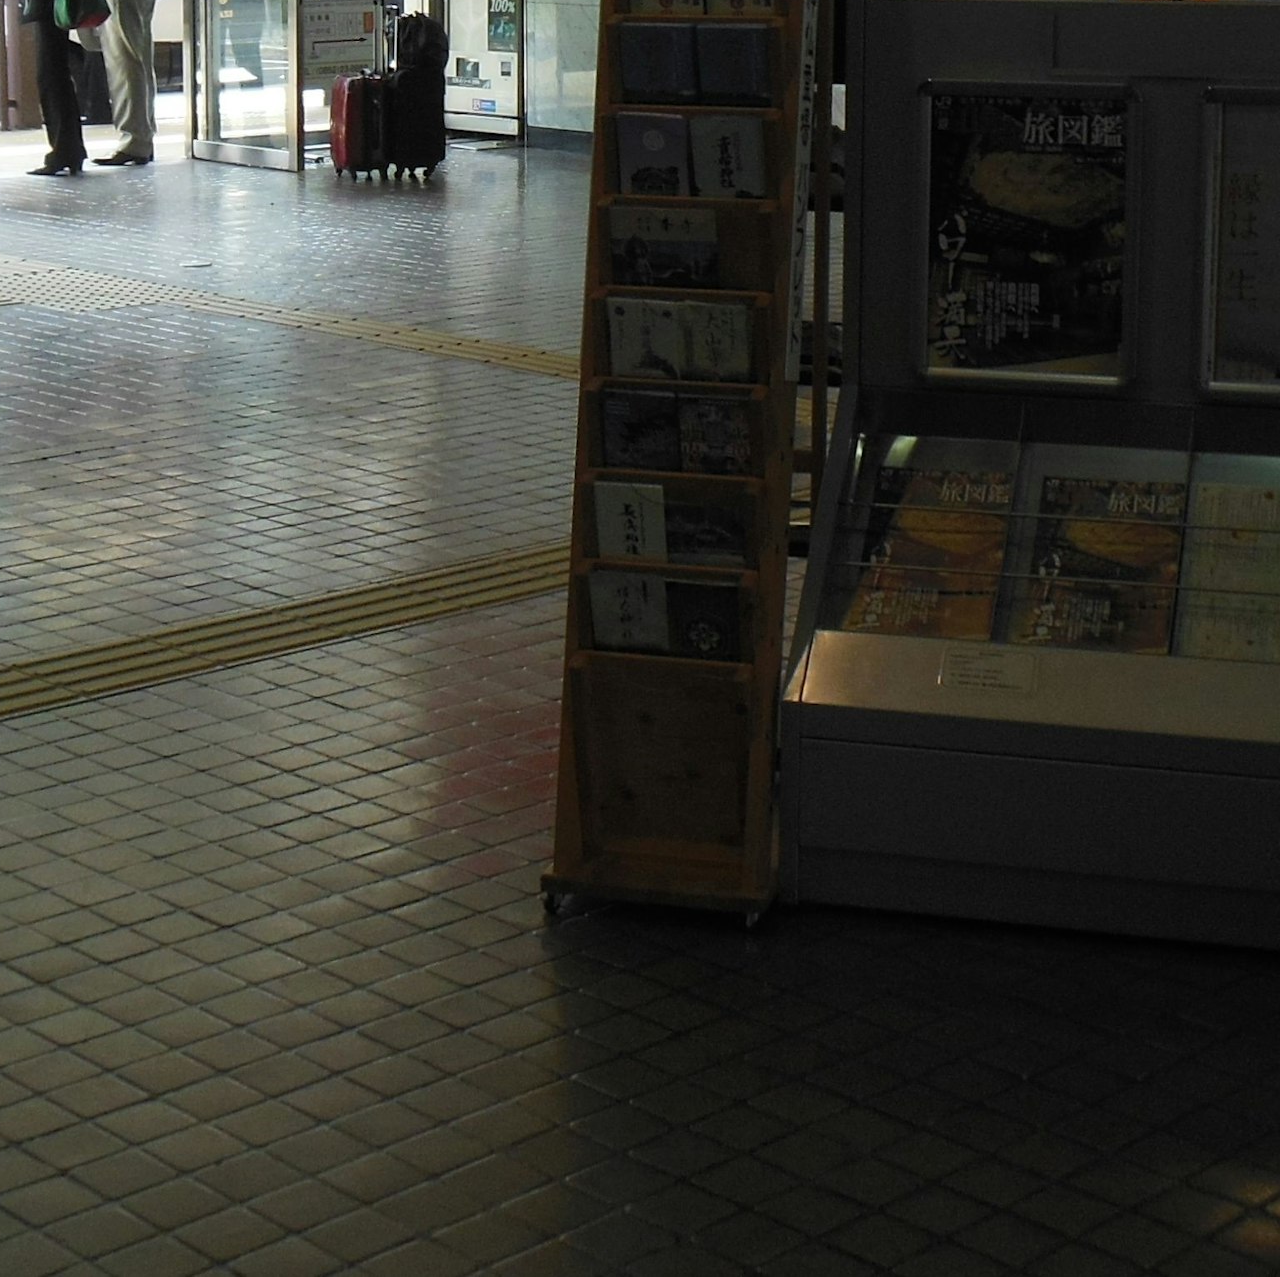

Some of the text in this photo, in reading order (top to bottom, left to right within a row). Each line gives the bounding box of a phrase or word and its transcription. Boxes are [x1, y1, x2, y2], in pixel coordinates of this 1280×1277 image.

[1023, 111, 1122, 147] 旅図鑑
[938, 481, 1010, 504] 旅図鑑
[1108, 492, 1182, 516] 旅図鑑
